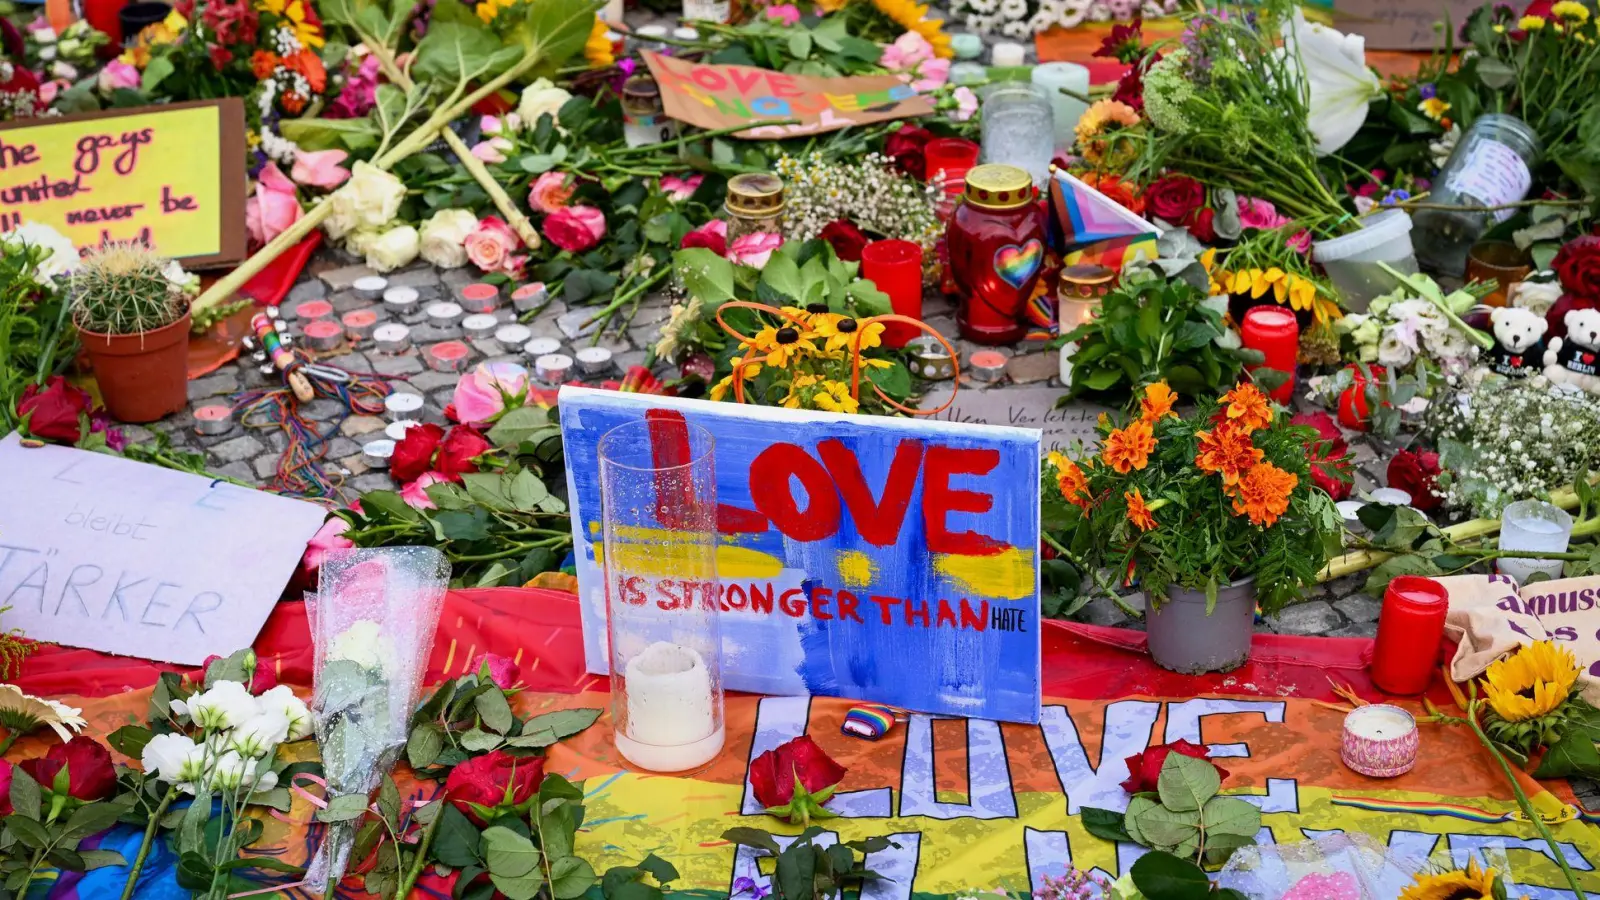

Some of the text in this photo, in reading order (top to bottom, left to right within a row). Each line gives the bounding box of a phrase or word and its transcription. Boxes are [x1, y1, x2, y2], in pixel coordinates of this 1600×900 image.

[650, 53, 806, 98] LOVE
[74, 128, 153, 174] gays
[1, 174, 91, 203] united
[67, 204, 143, 224] never
[162, 186, 197, 212] be
[1567, 360, 1596, 375] BERLIN
[645, 409, 1015, 556] LOVE
[63, 503, 157, 541] bleibt
[618, 577, 1028, 634] IS STRONGER THAN HATE
[740, 695, 1300, 819] LOVE
